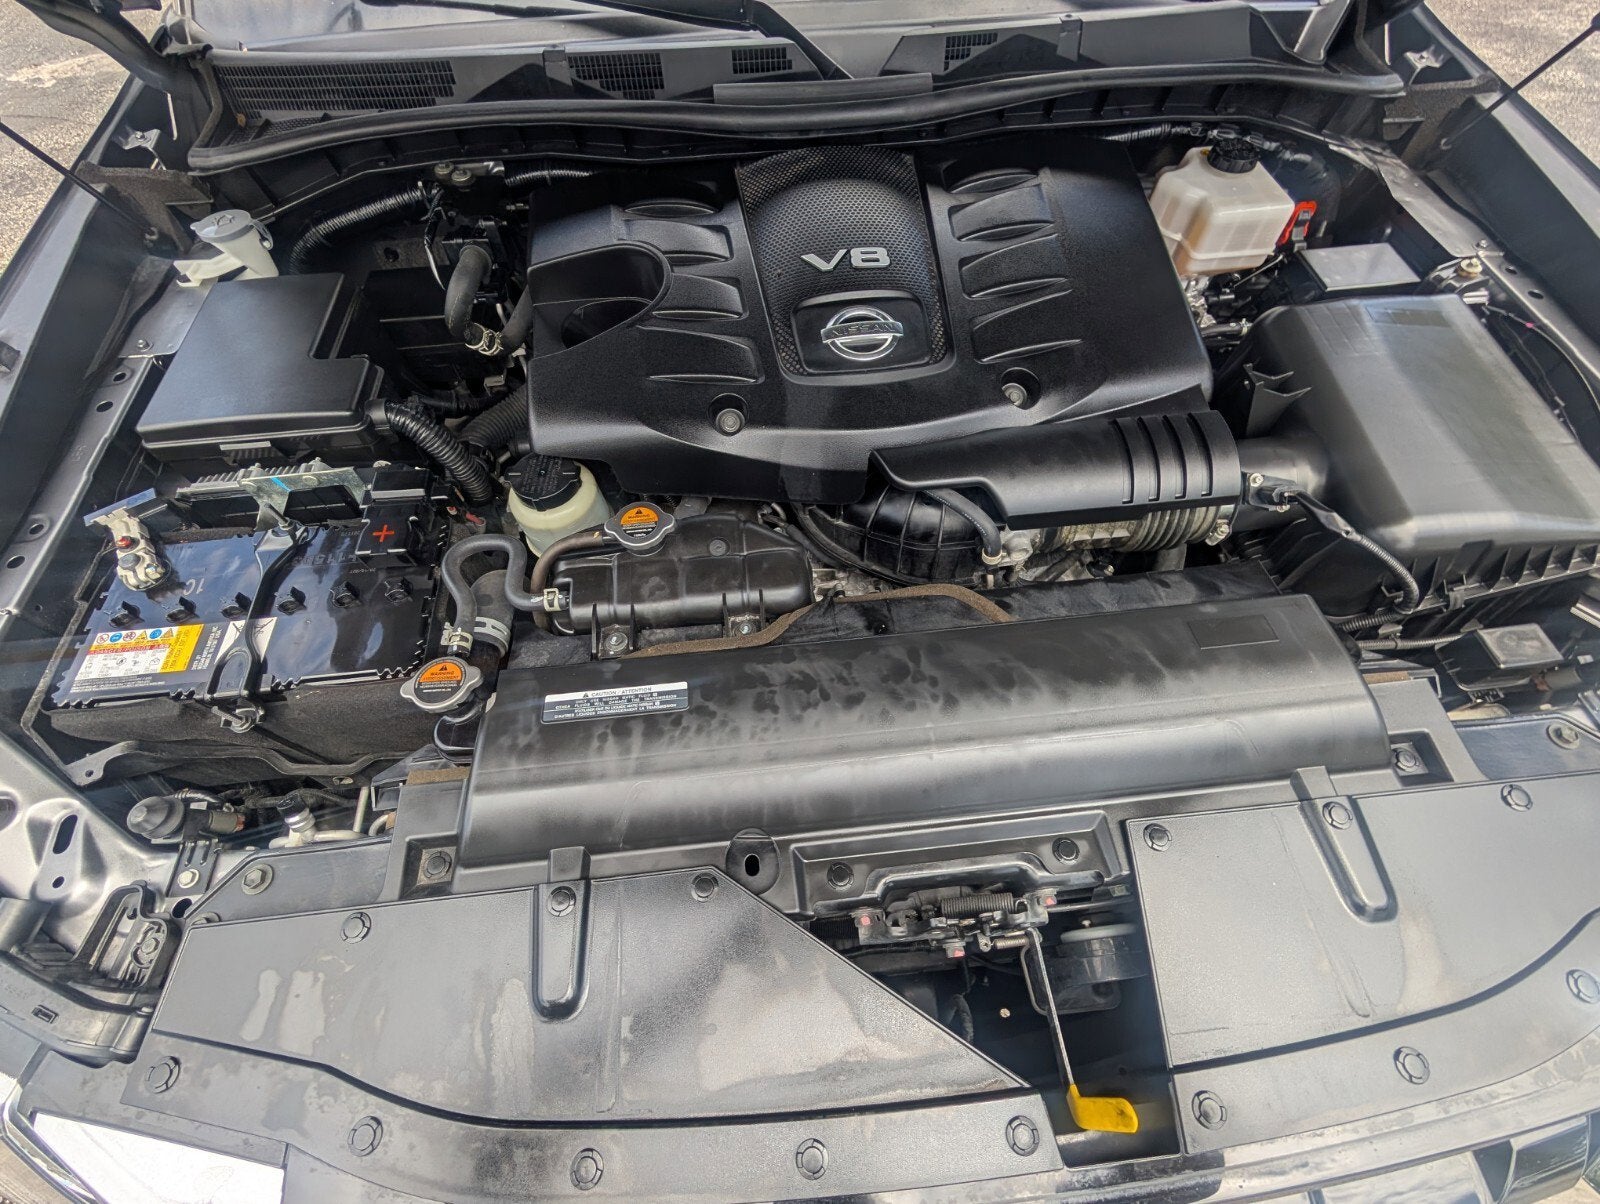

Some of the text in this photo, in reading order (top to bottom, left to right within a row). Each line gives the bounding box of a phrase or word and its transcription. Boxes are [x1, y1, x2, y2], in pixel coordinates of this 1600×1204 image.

[800, 246, 891, 272] V8
[832, 324, 897, 337] NISSAN
[621, 686, 652, 694] ATTENTION
